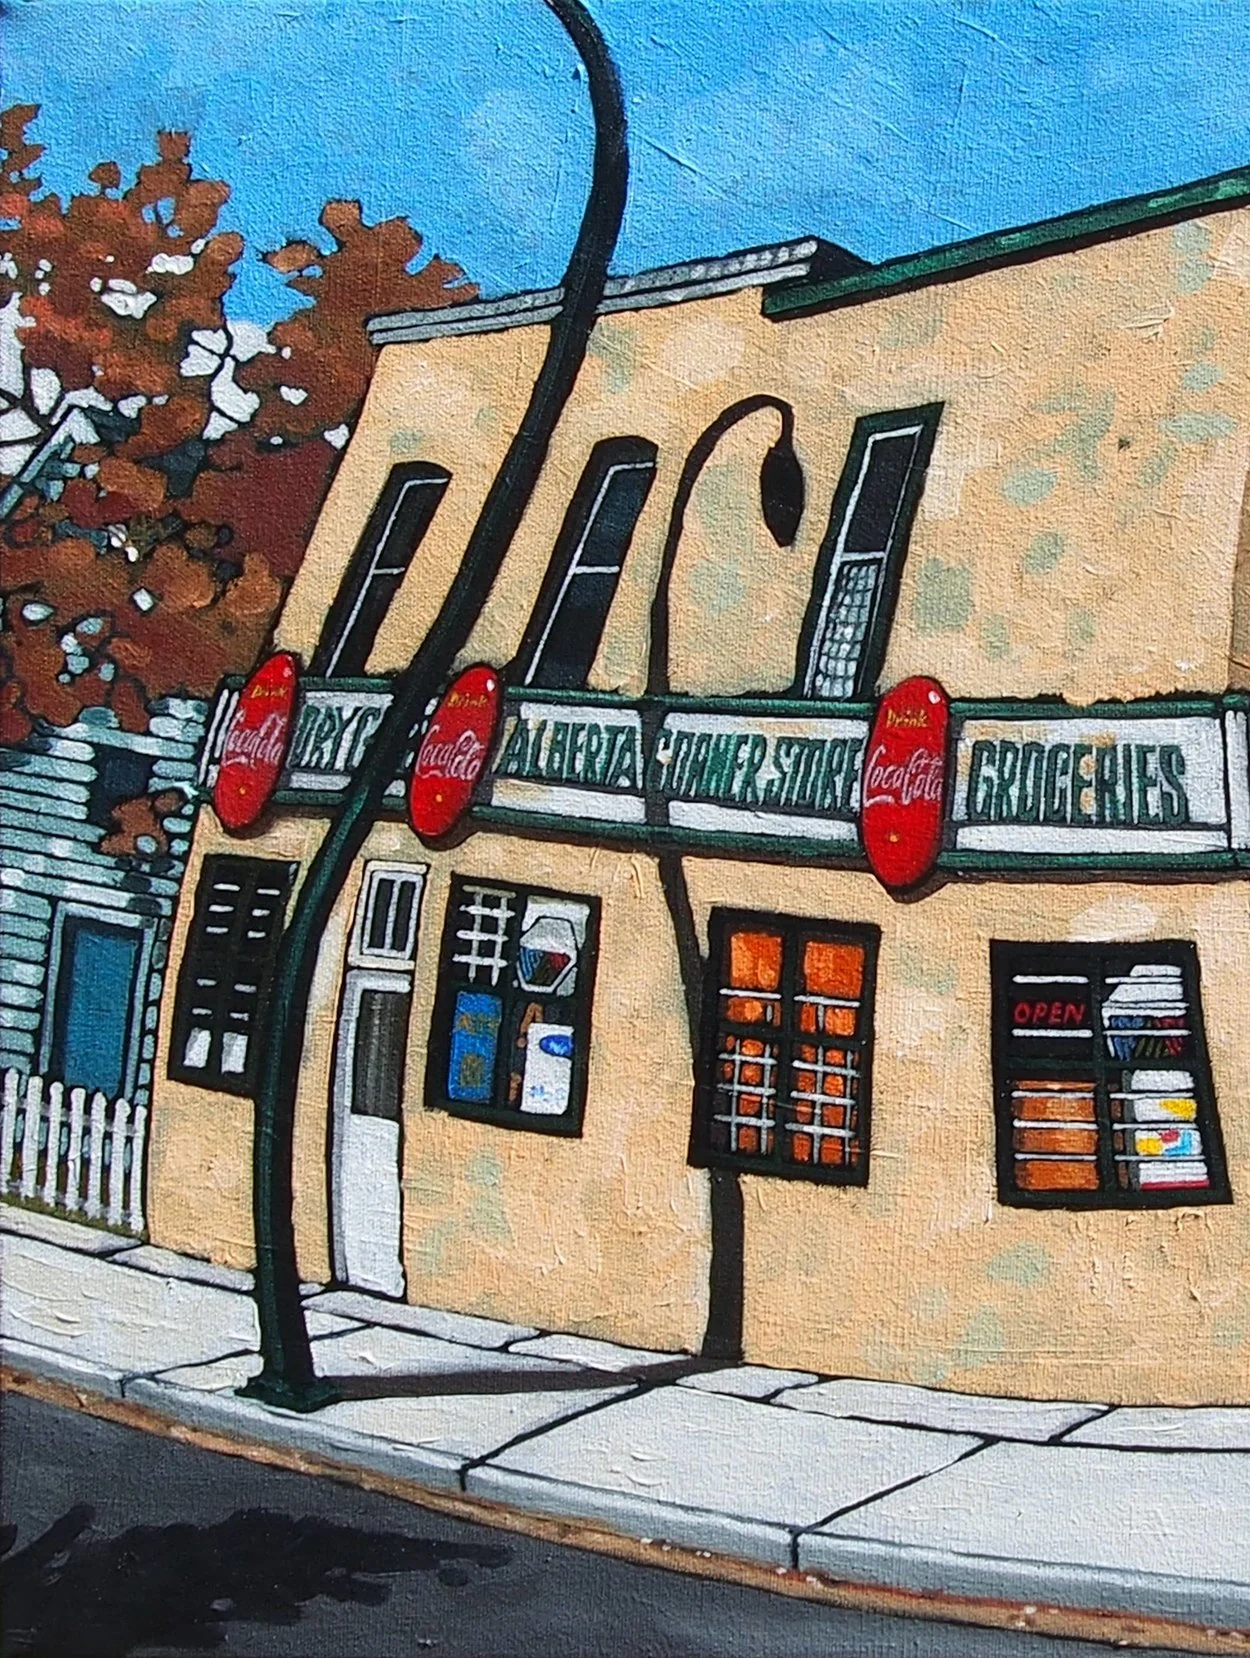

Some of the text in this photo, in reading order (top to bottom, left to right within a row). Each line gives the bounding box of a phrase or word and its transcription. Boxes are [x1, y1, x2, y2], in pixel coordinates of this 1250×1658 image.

[499, 717, 638, 789] ALBERTA
[886, 708, 928, 729] Drink
[651, 728, 863, 811] CORNER STORE
[966, 739, 1189, 825] GROCERIES
[1012, 1001, 1087, 1025] OPEN
